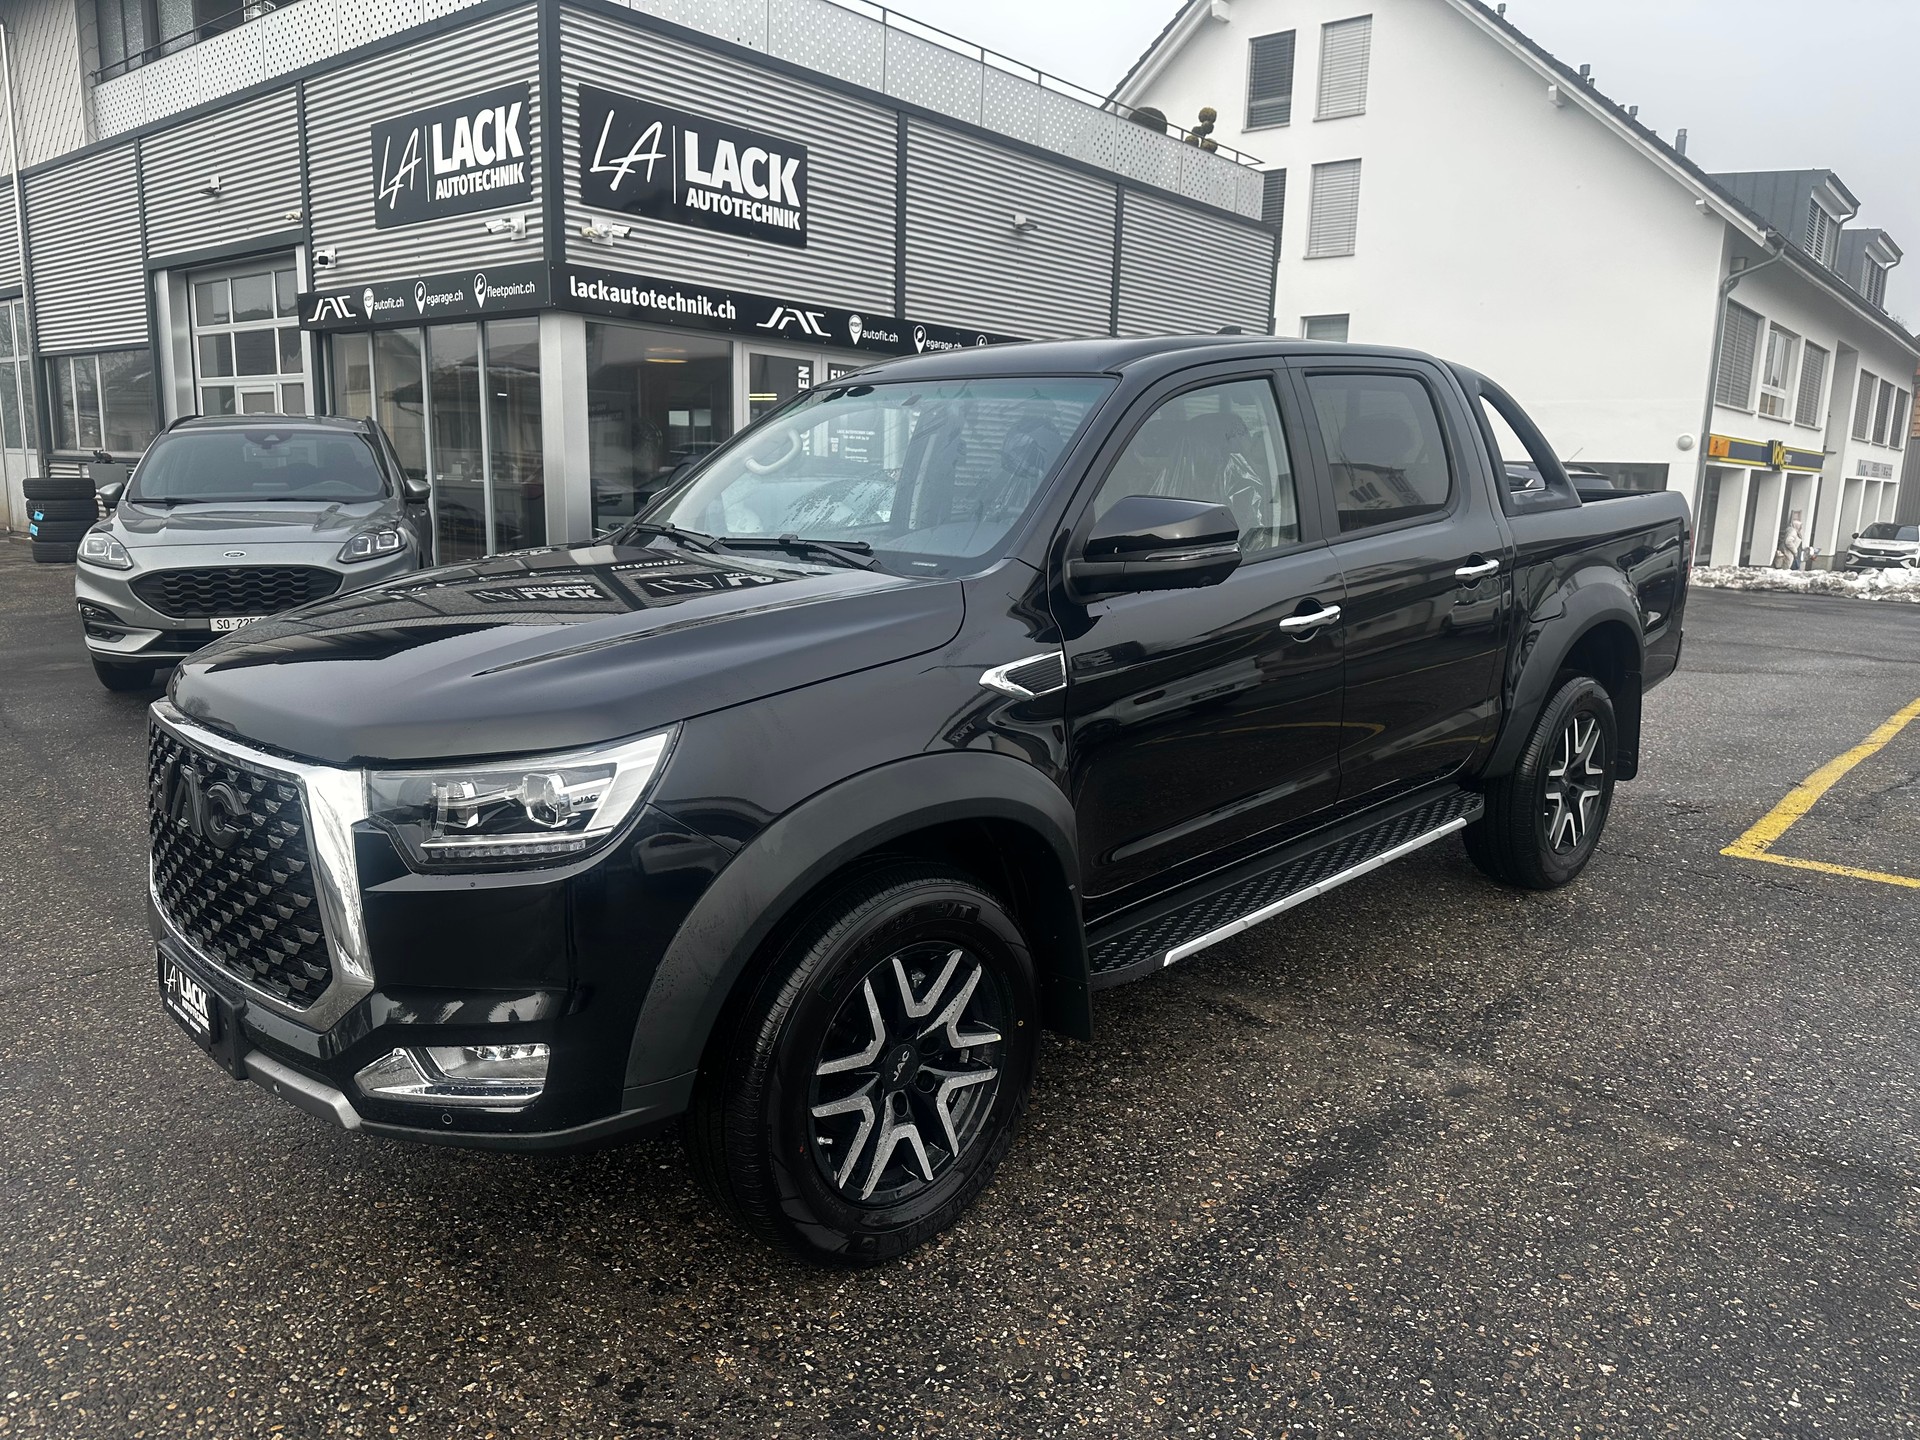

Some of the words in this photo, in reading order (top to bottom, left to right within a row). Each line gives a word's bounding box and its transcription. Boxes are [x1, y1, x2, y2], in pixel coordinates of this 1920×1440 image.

[432, 101, 524, 174] LACK
[436, 161, 525, 201] AUTOTECHNIK
[684, 130, 801, 207] LACK
[686, 186, 801, 231] AUTOTECHNIK
[374, 297, 405, 311] autofit.ch
[426, 289, 464, 306] egarage.ch
[486, 281, 536, 299] fleetpoint.ch
[569, 275, 737, 320] lackautotechnik.ch
[862, 329, 899, 343] autofit.ch
[925, 339, 963, 350] egaragech
[216, 619, 230, 630] SO
[178, 970, 210, 1020] LACK
